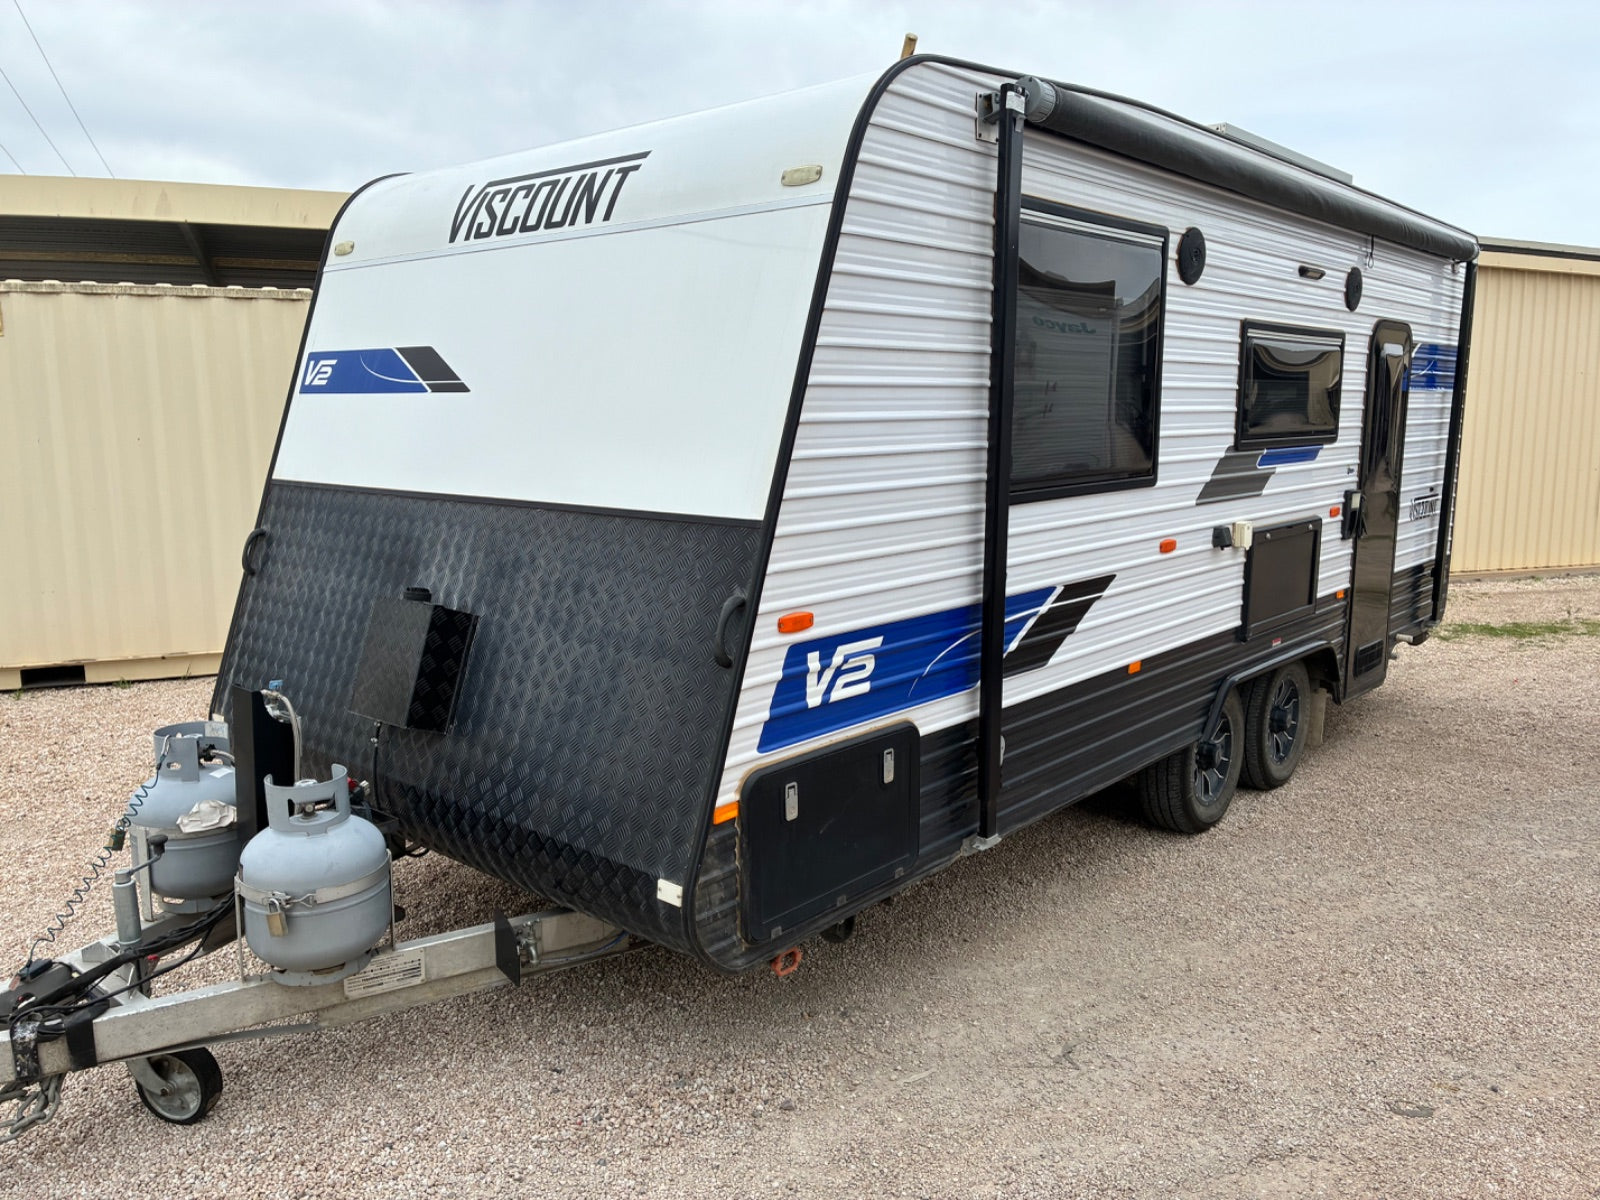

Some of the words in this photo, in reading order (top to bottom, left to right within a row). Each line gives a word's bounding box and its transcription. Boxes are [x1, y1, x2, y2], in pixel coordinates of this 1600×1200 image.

[449, 150, 652, 243] VISCOUNT
[305, 359, 338, 386] V2
[806, 635, 884, 709] V2
